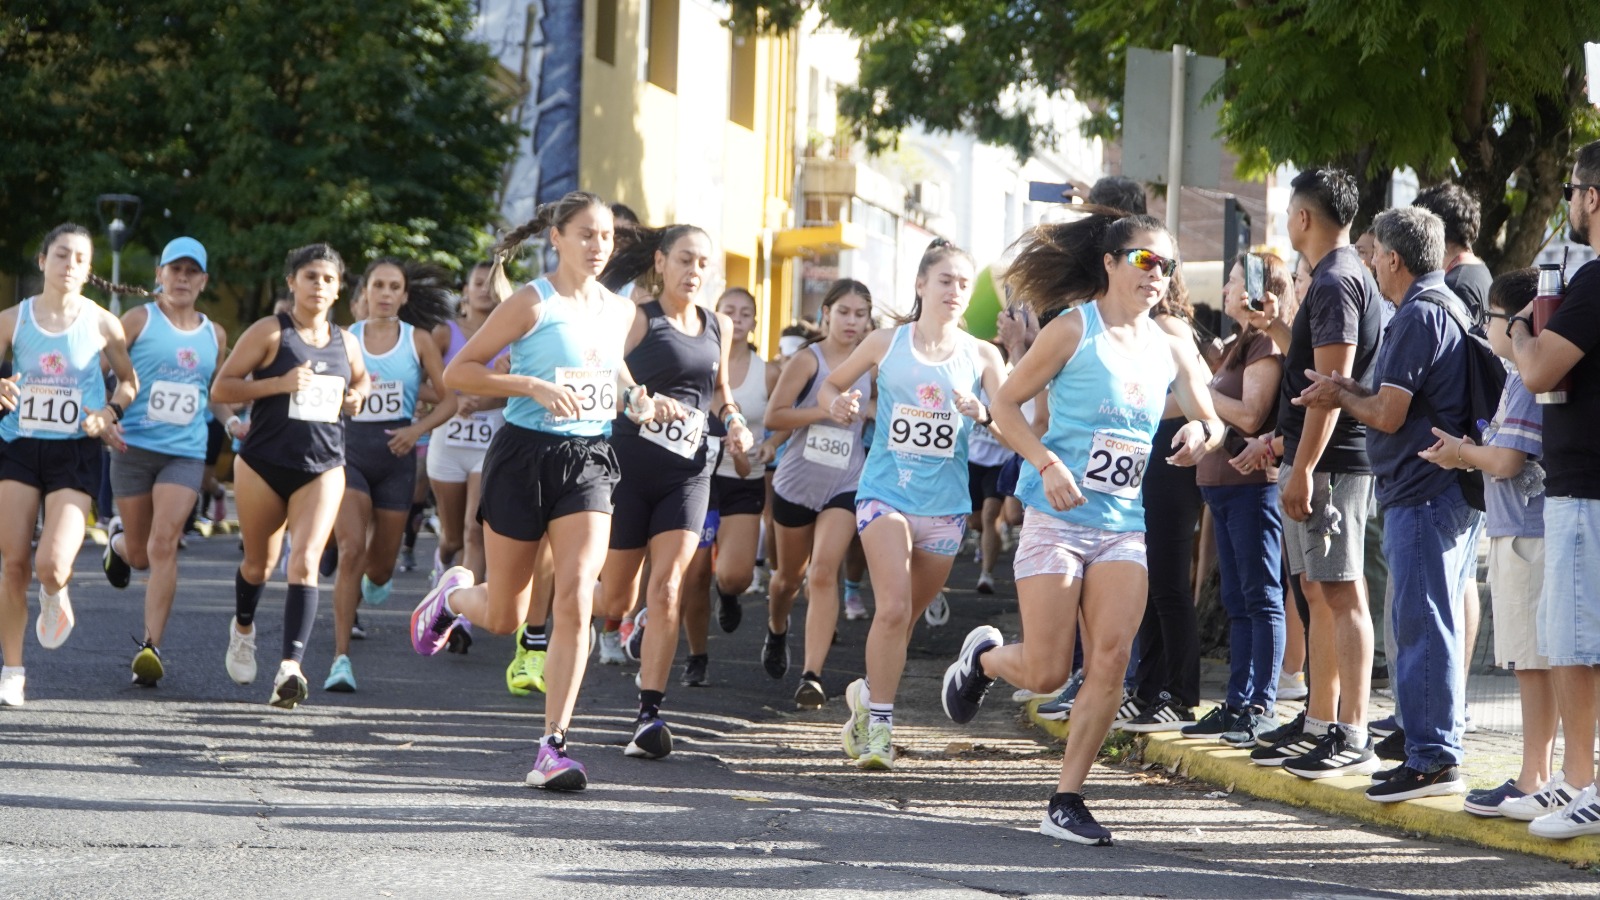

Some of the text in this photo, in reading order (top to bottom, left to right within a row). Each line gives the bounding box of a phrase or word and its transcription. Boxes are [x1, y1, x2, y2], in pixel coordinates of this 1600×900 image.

[21, 395, 79, 424] 110
[151, 390, 196, 414] 673
[900, 407, 951, 420] cronomet
[447, 421, 492, 443] 219
[892, 418, 953, 449] 938
[806, 436, 850, 457] 1380
[1086, 449, 1146, 489] 288
[1051, 809, 1070, 828] N
